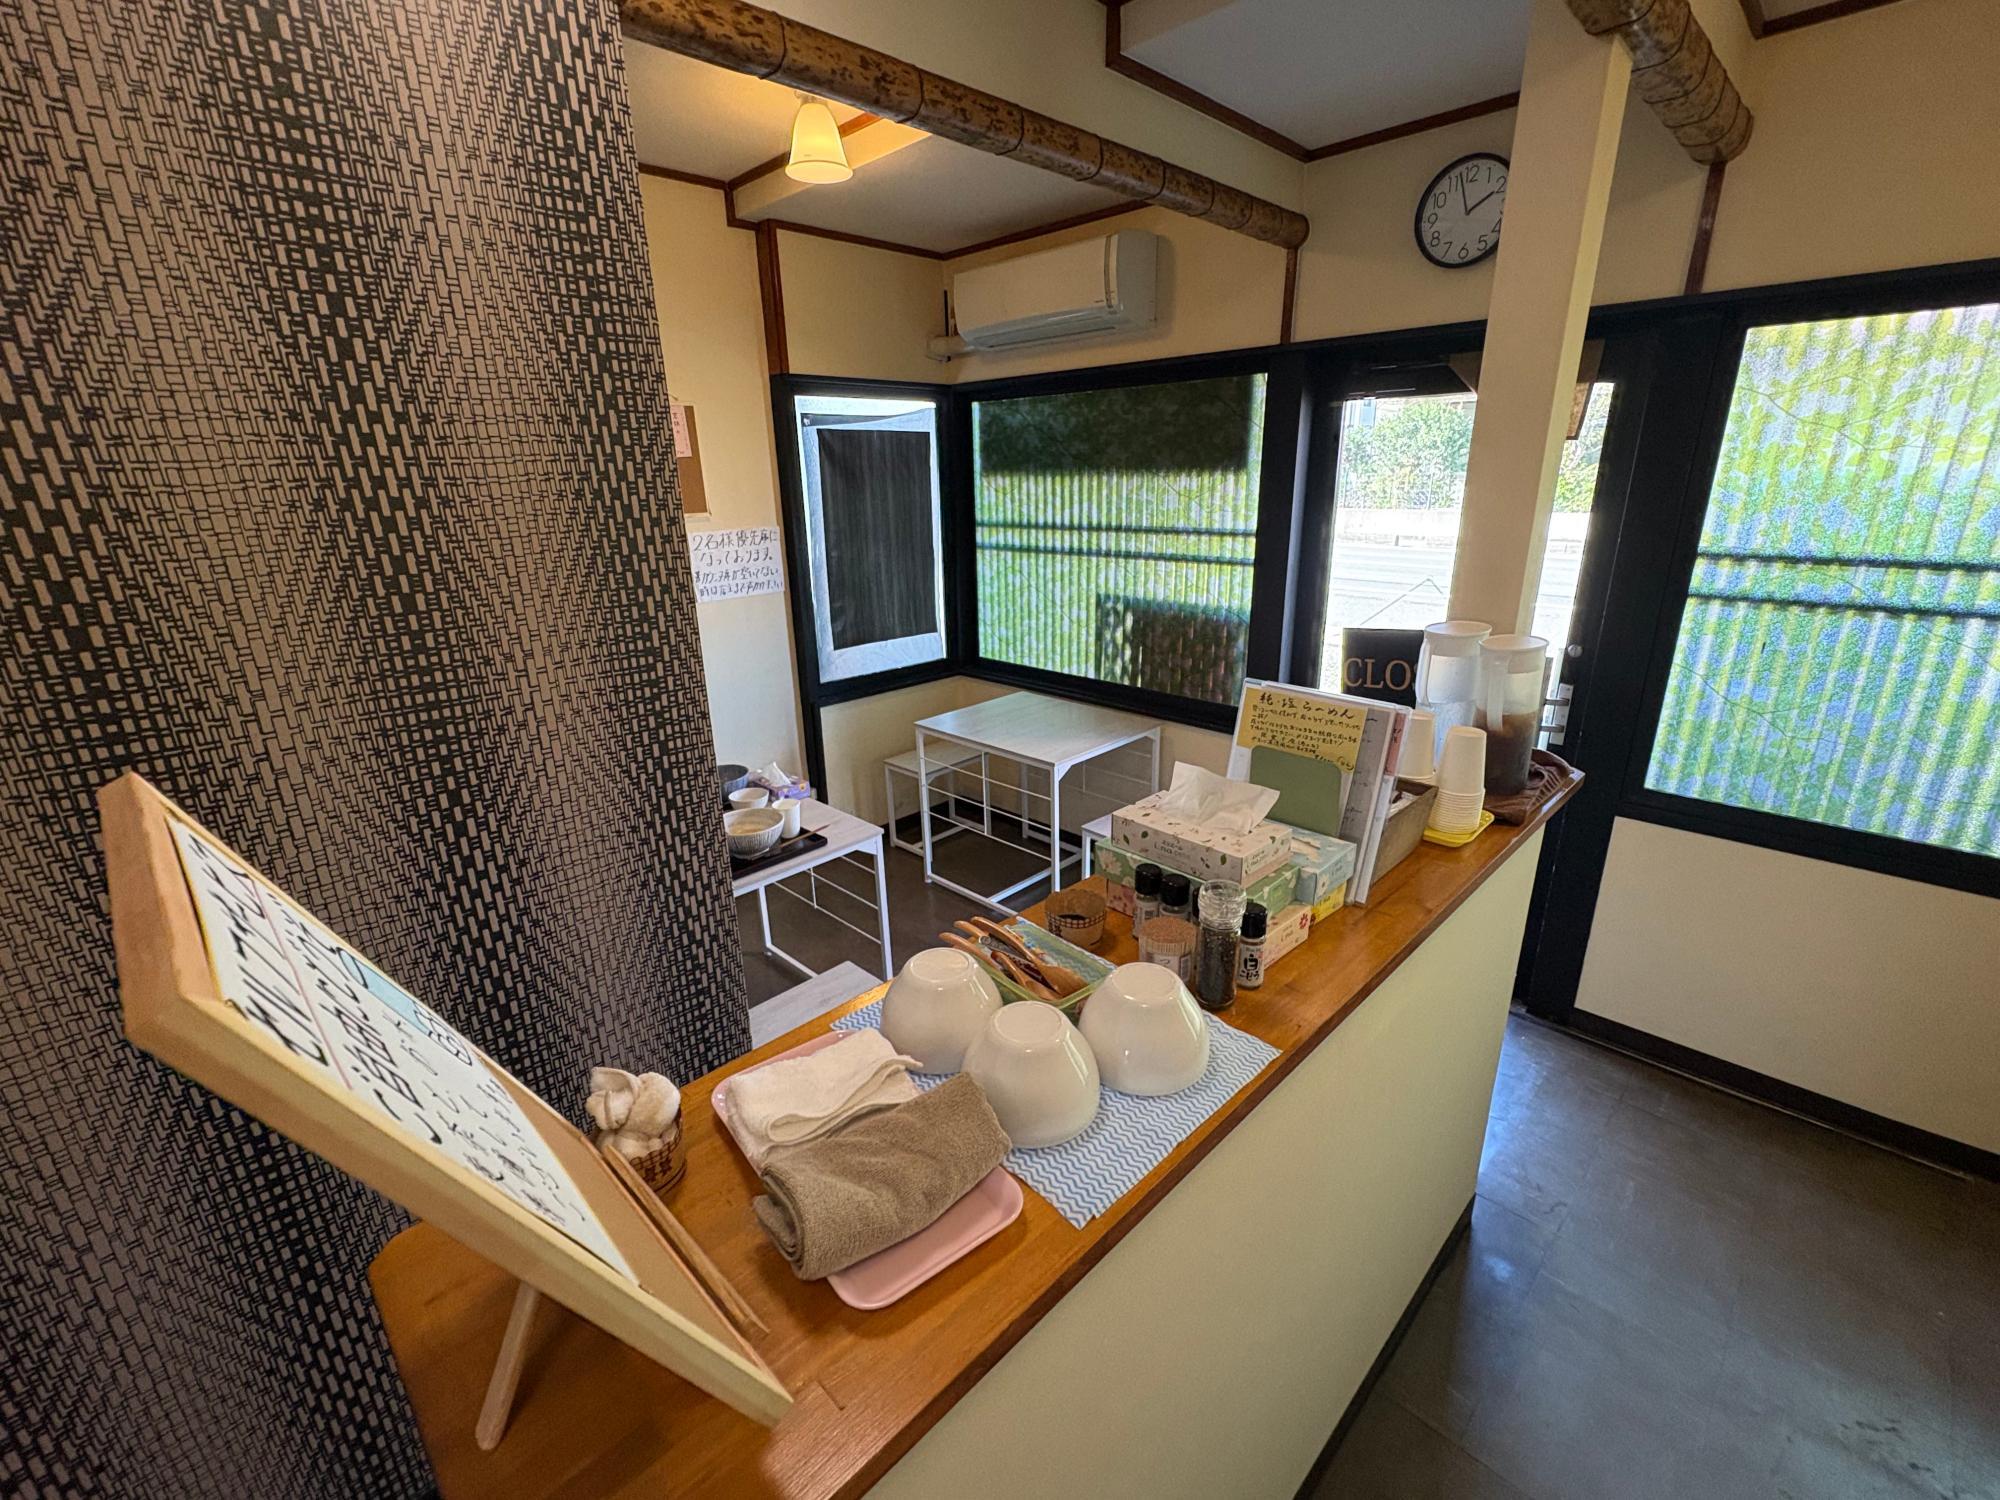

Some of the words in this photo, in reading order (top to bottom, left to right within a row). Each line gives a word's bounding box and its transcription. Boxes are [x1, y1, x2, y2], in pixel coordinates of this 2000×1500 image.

[1465, 165, 1480, 183] 12
[1487, 167, 1492, 183] 1
[1448, 175, 1459, 192] 11
[1496, 176, 1506, 193] 2
[1432, 192, 1447, 209] 10
[1428, 213, 1438, 228] 9
[1431, 231, 1440, 247] 8
[1477, 235, 1488, 251] 5
[1442, 242, 1452, 259] 7
[1458, 243, 1468, 259] 6
[189, 834, 330, 1067] セルフサービス
[266, 892, 443, 1146] ご自由にどうぞ
